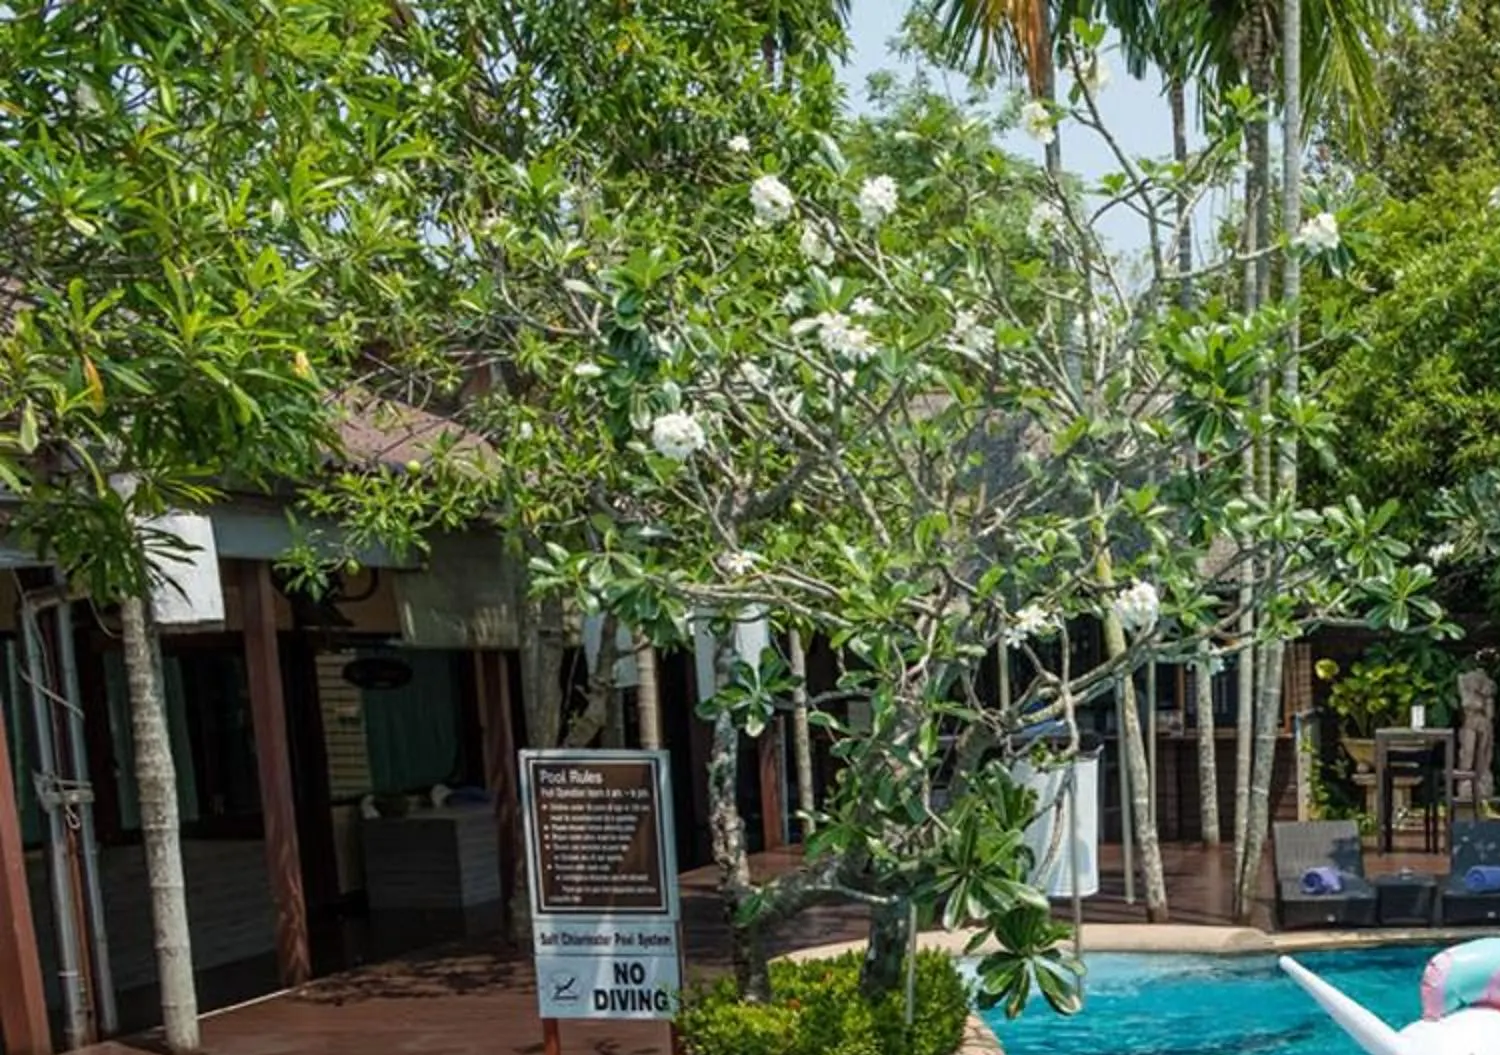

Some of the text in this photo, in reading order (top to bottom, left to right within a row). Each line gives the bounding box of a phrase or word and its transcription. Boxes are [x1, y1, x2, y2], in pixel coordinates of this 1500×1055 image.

[540, 769, 603, 784] Pool Rules
[614, 931, 634, 946] Pool
[637, 932, 671, 949] System
[613, 961, 646, 986] NO
[592, 988, 672, 1012] DIVING
